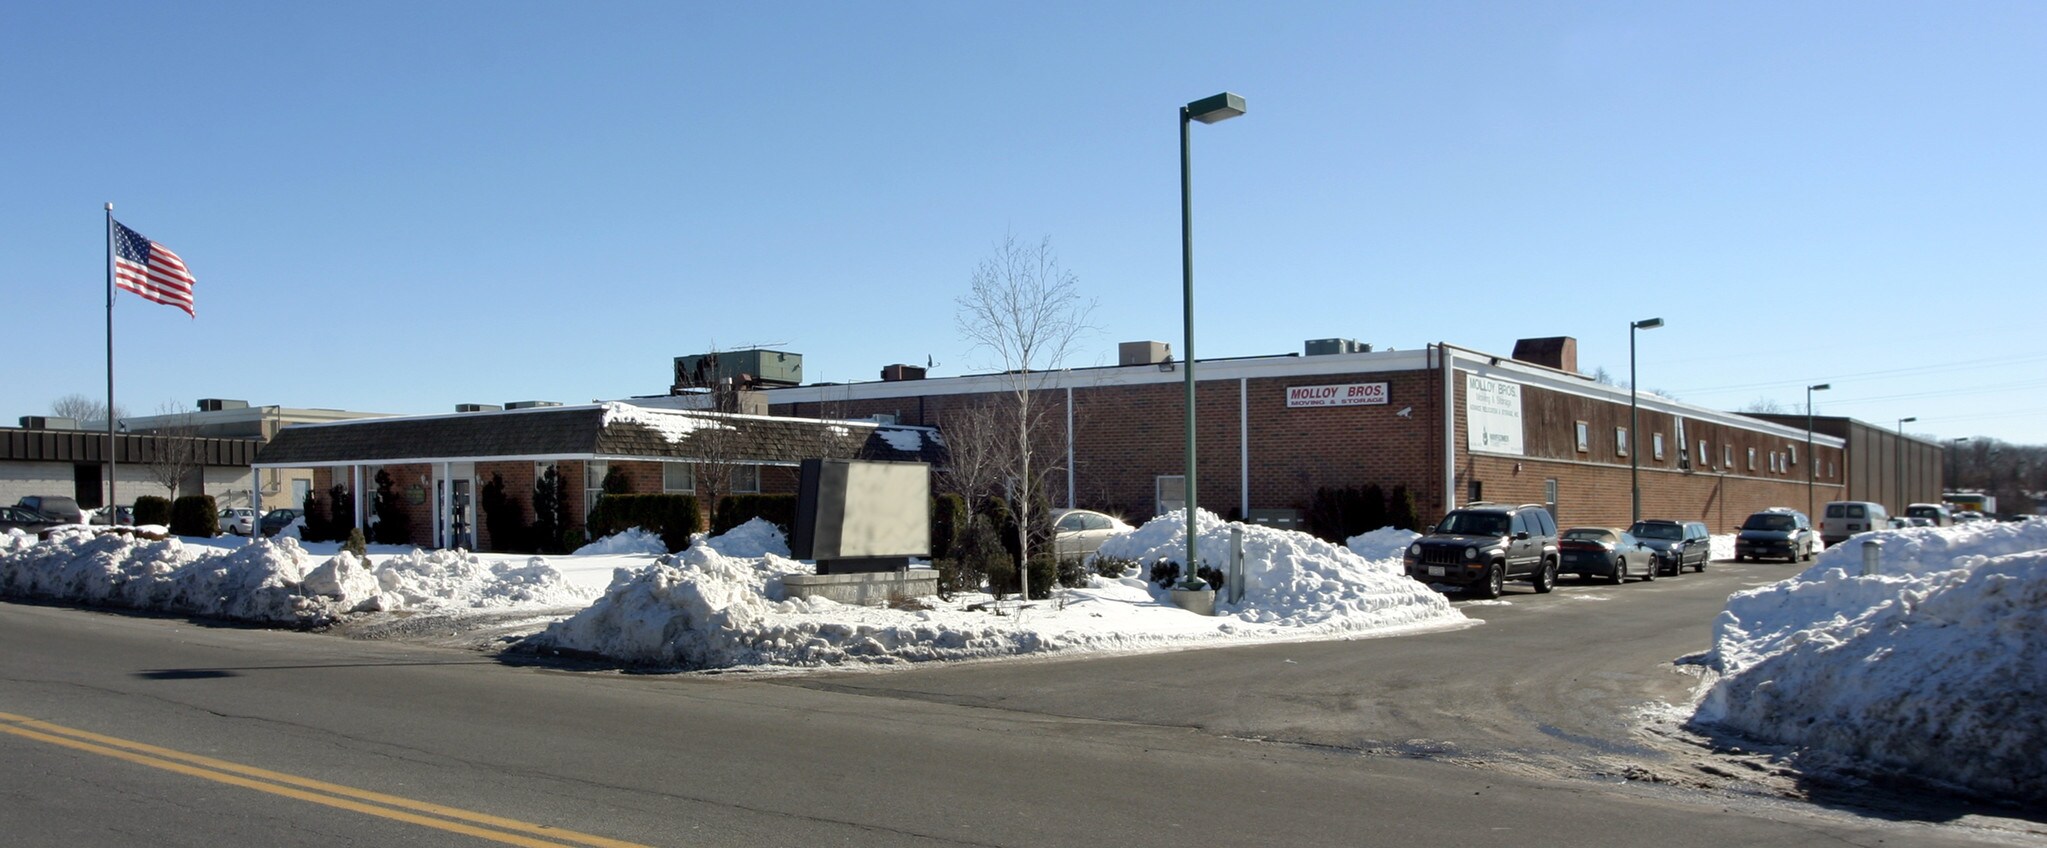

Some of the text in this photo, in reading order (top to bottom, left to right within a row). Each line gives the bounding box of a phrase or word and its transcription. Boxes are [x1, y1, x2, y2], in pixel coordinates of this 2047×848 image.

[1291, 385, 1384, 399] MOLLOY BROS.
[1470, 378, 1495, 393] MOLLOY
